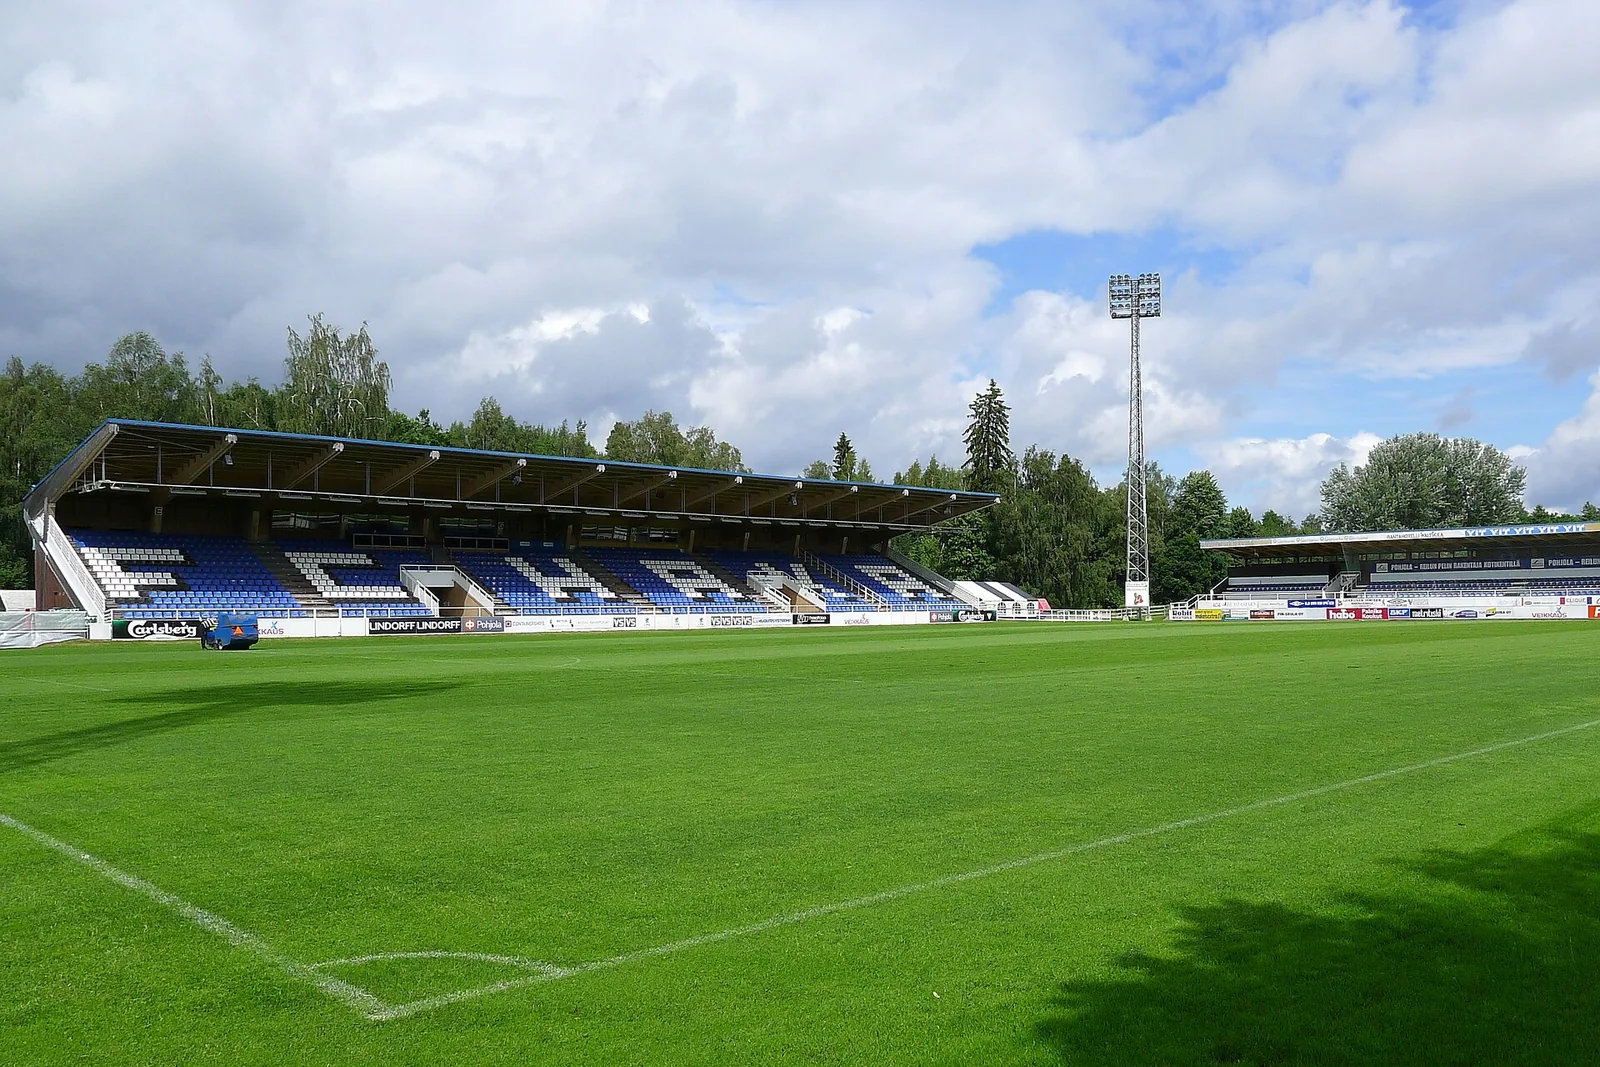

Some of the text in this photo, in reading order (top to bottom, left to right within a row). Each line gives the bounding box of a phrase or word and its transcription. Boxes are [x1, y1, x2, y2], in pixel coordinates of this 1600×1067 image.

[711, 616, 721, 626] VS
[722, 616, 731, 626] VS
[732, 616, 742, 625] VS
[743, 616, 752, 625] VS
[958, 611, 985, 622] Carlsberg
[369, 621, 416, 631] LINDORFF
[416, 620, 461, 630] LINDORFF
[476, 619, 502, 630] Pohjola
[613, 617, 624, 627] VS
[625, 617, 636, 627] VS
[127, 620, 198, 638] Carlsberg
